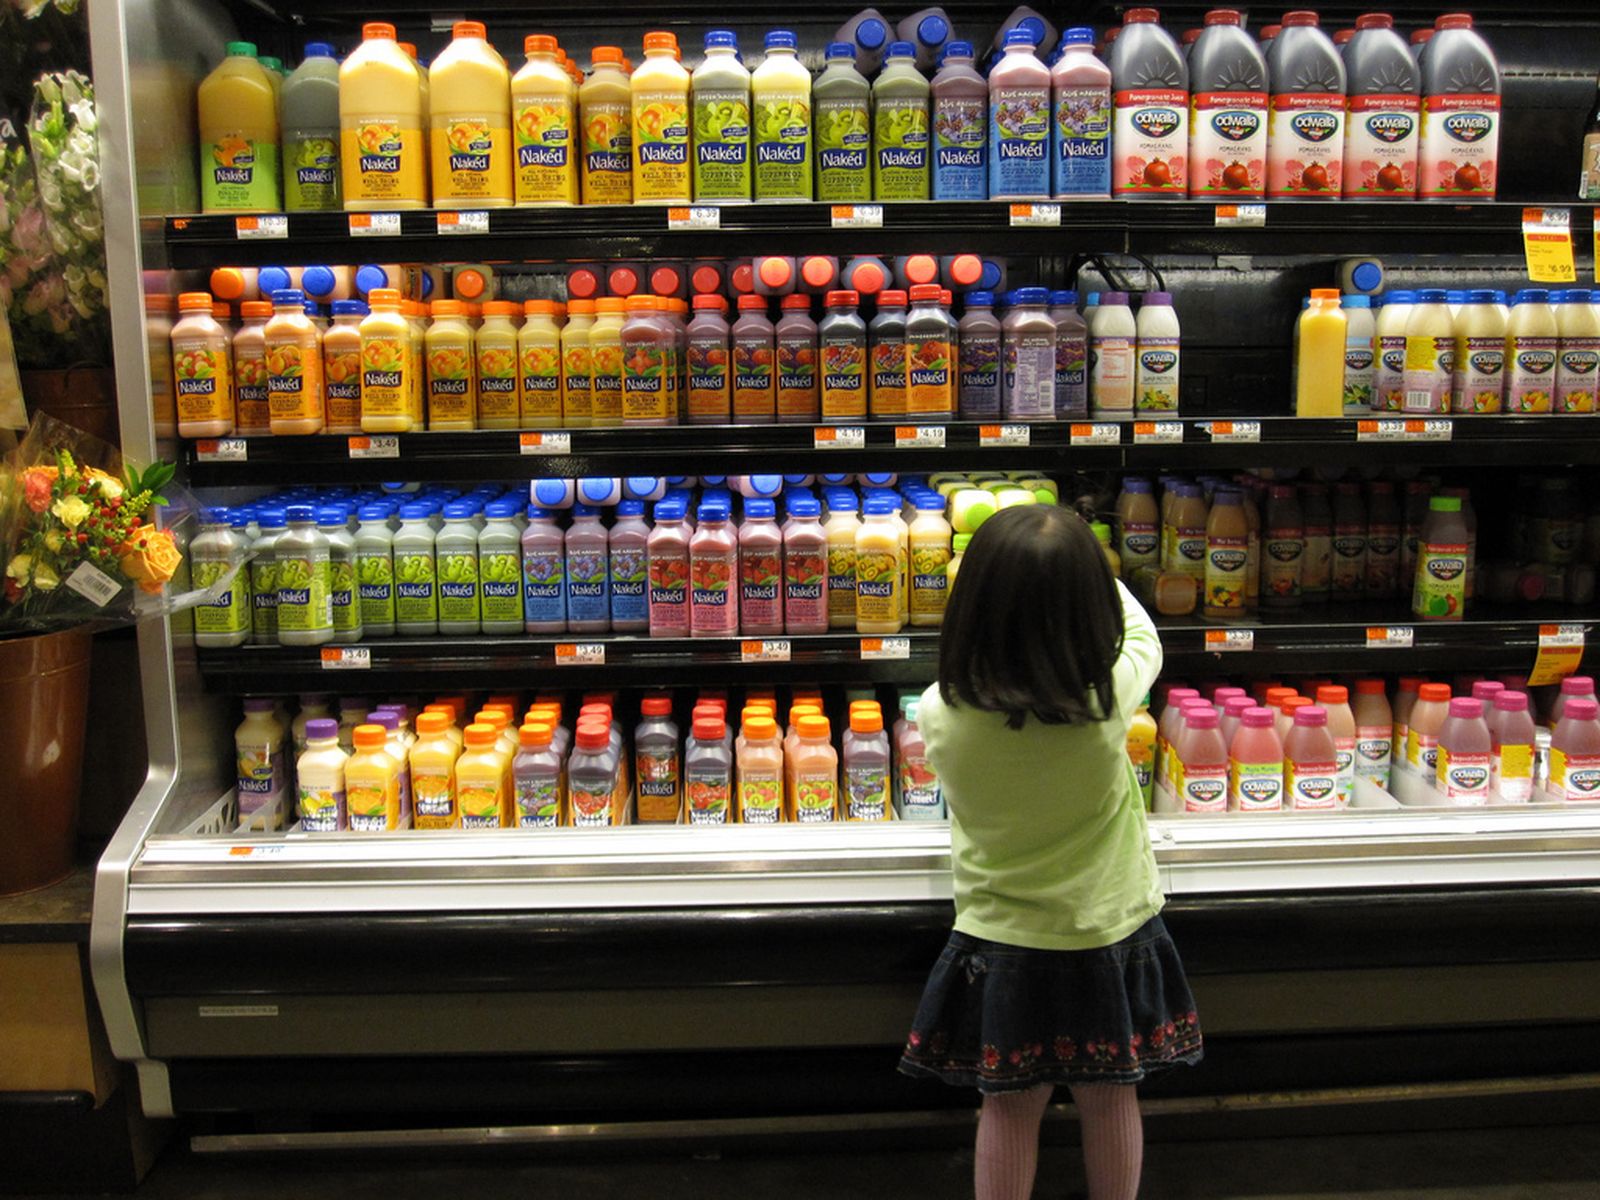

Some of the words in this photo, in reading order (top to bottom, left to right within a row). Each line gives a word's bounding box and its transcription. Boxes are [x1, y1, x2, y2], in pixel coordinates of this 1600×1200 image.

[1129, 93, 1169, 102] Pomegranate
[1209, 95, 1250, 104] Pomegranate
[1290, 96, 1330, 105] Pomegranate
[1364, 98, 1404, 107] Pomegranate
[1442, 98, 1482, 107] Pomegranate
[642, 145, 685, 162] Naked
[700, 145, 743, 161] Naked
[759, 145, 801, 161] Naked
[1001, 142, 1043, 158] Naked
[1063, 141, 1104, 157] Naked
[452, 156, 487, 170] Naked
[521, 149, 564, 165] Naked
[589, 156, 630, 170] Naked
[822, 151, 863, 167] Naked
[881, 150, 922, 166] Naked
[940, 149, 981, 166] Naked
[362, 157, 397, 171] Naked
[216, 169, 249, 183] Naked
[299, 169, 332, 183] Naked
[366, 372, 399, 386] Naked
[526, 377, 556, 390] Naked
[691, 376, 722, 390] Naked
[737, 376, 768, 390] Naked
[780, 376, 811, 390] Naked
[826, 375, 859, 388] Naked
[912, 371, 945, 384] Naked
[963, 372, 994, 386] Naked
[179, 380, 213, 394] Naked
[433, 380, 465, 393] Naked
[482, 379, 513, 391] Naked
[626, 378, 659, 391] Naked
[613, 583, 642, 595] Naked
[859, 583, 890, 596] Naked
[915, 577, 945, 589] Naked
[278, 590, 306, 603] Naked
[399, 585, 429, 597] Naked
[442, 585, 473, 597] Naked
[485, 584, 515, 596] Naked
[528, 585, 559, 597] Naked
[571, 584, 601, 596] Naked
[744, 587, 775, 599] Naked
[788, 585, 820, 597] Naked
[652, 591, 683, 603] Naked
[693, 592, 724, 604] Naked
[239, 780, 268, 791] Naked
[642, 784, 673, 795] Naked
